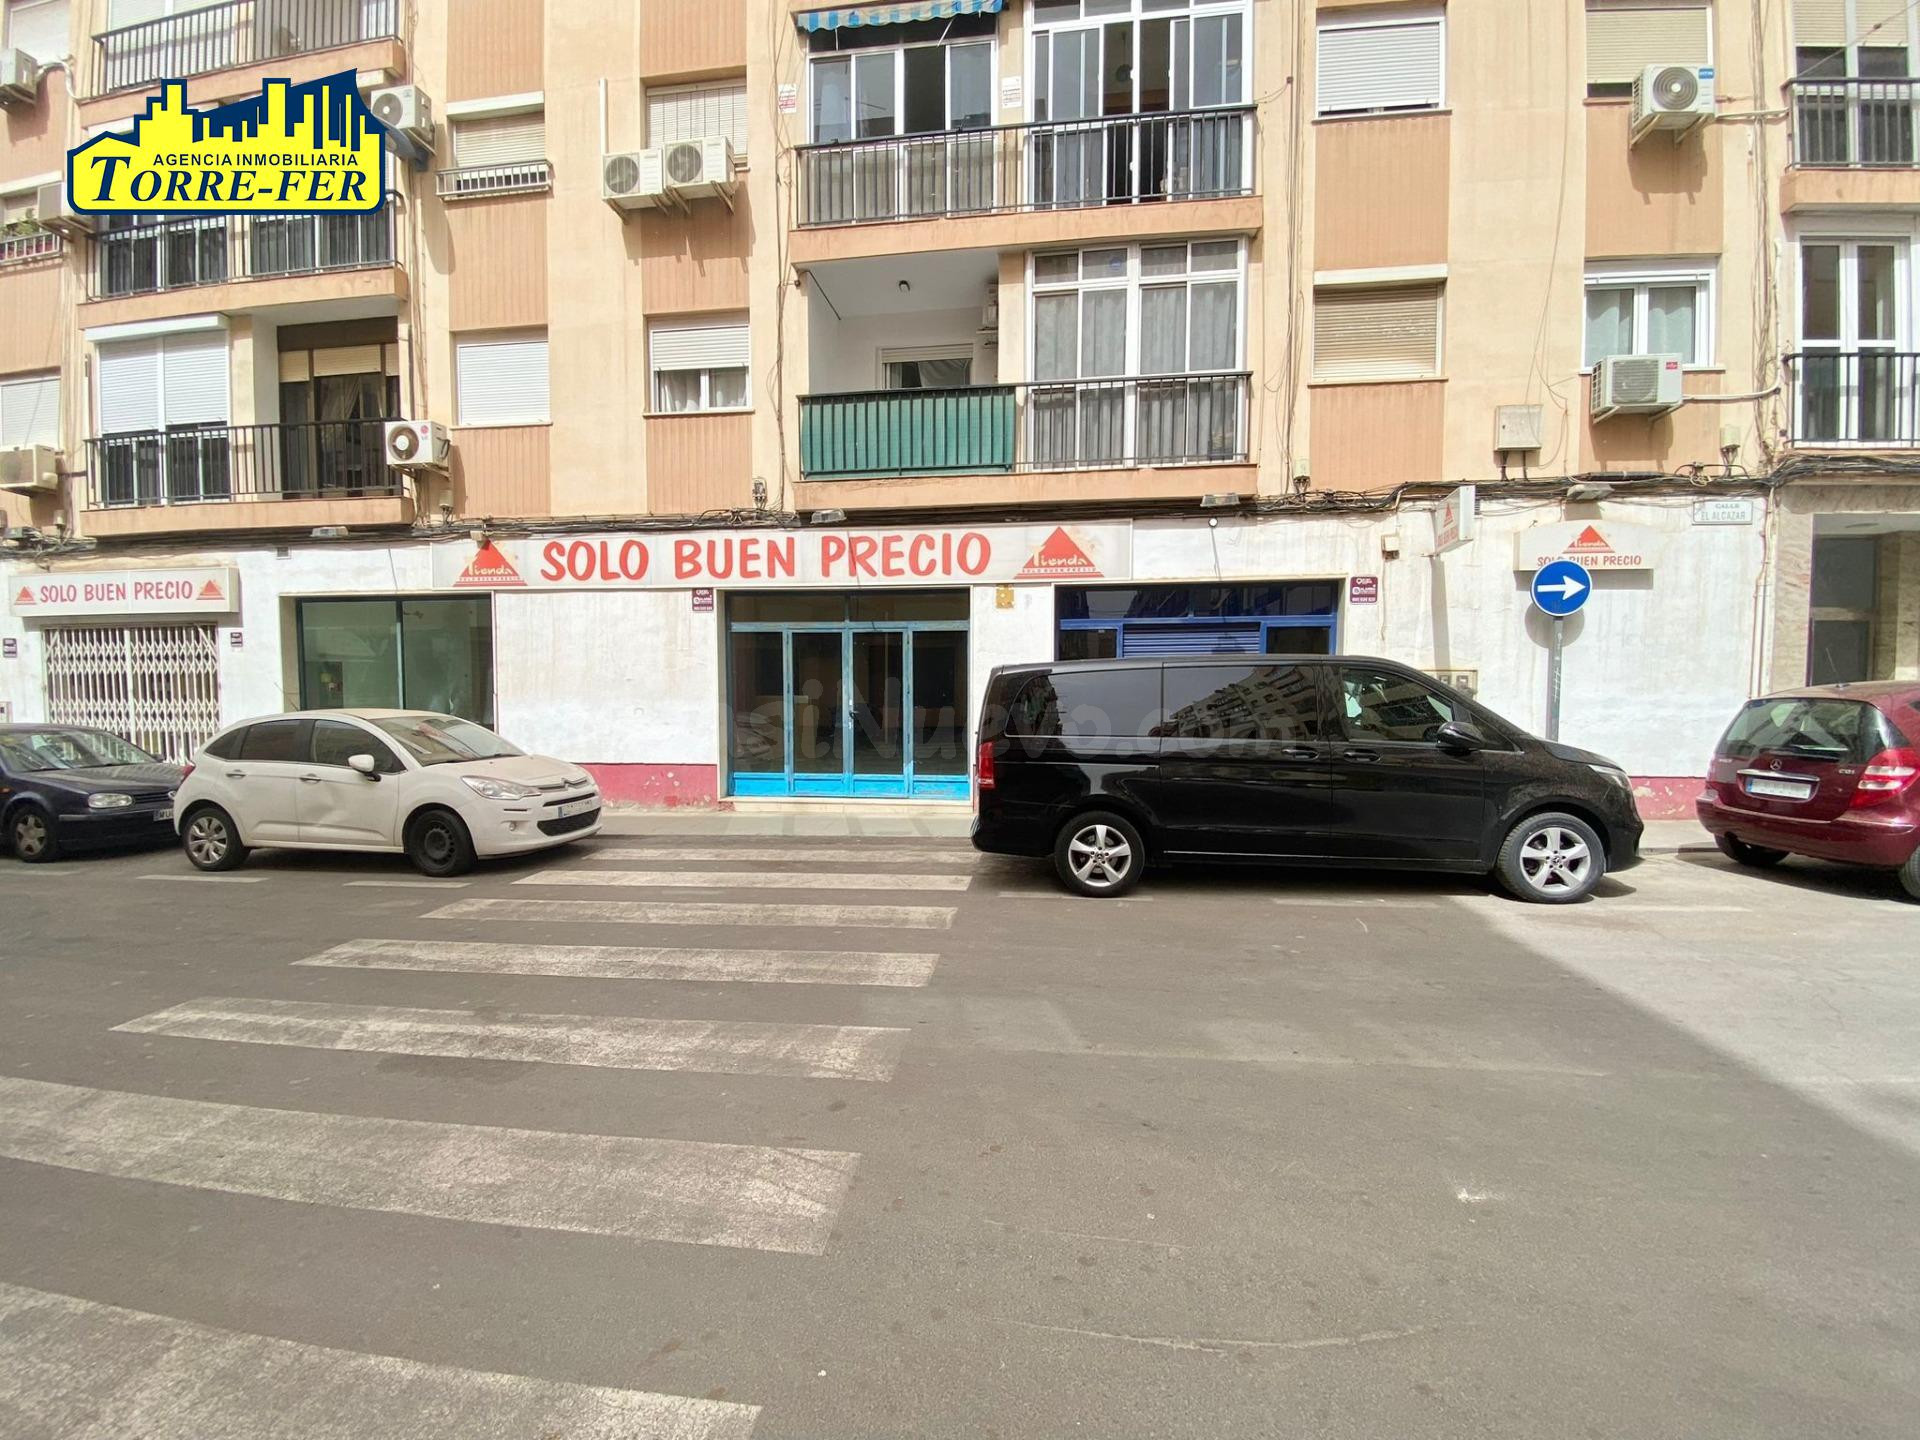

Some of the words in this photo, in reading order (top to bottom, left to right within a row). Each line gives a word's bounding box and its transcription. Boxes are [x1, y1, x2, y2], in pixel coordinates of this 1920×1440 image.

[540, 539, 649, 581] SOLO
[674, 538, 795, 580] BUEN
[821, 532, 991, 578] PRECIO
[1603, 555, 1642, 566] PRECIO
[40, 585, 77, 603] SOLO
[84, 582, 126, 601] BUEN
[134, 580, 193, 600] PRECIO
